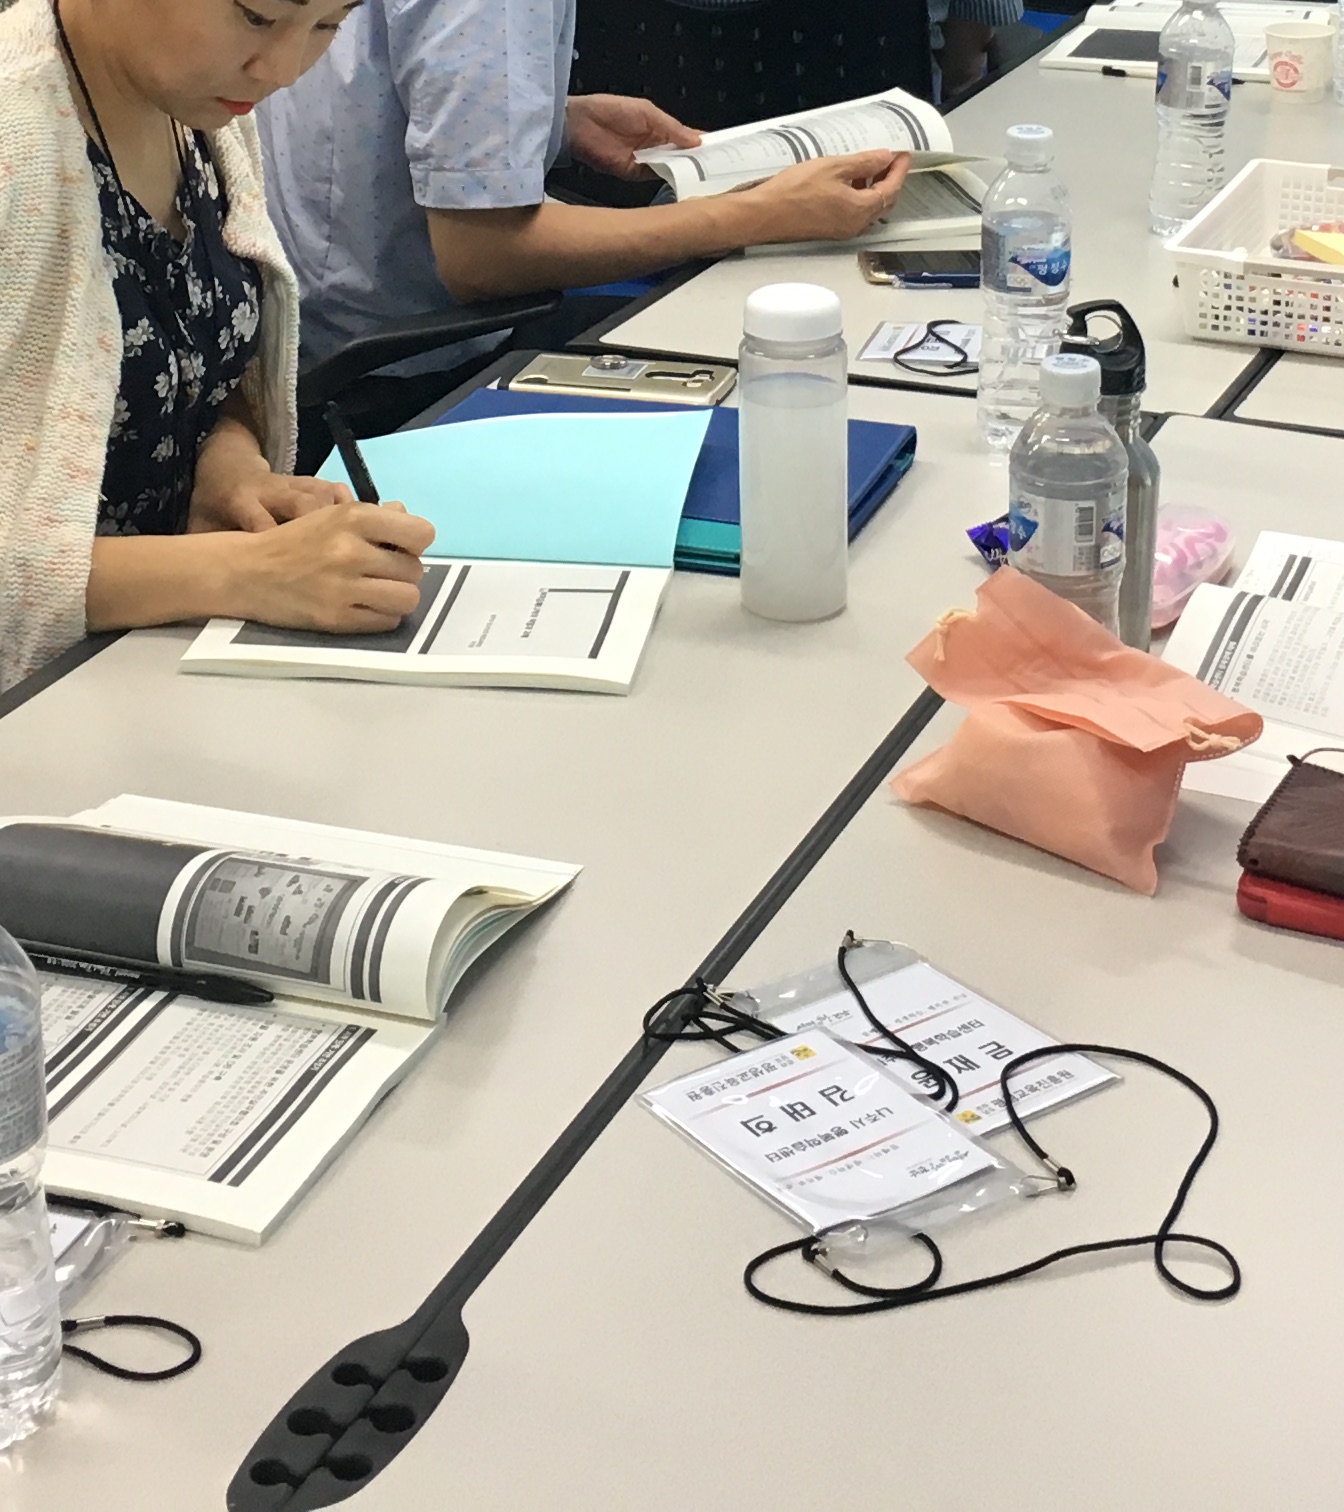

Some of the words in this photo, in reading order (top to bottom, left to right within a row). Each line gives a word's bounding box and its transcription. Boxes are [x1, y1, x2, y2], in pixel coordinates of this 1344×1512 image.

[685, 1061, 779, 1103] 평생교육진흥원
[849, 1106, 895, 1130] 나주시
[763, 1125, 850, 1164] 행복학습센터
